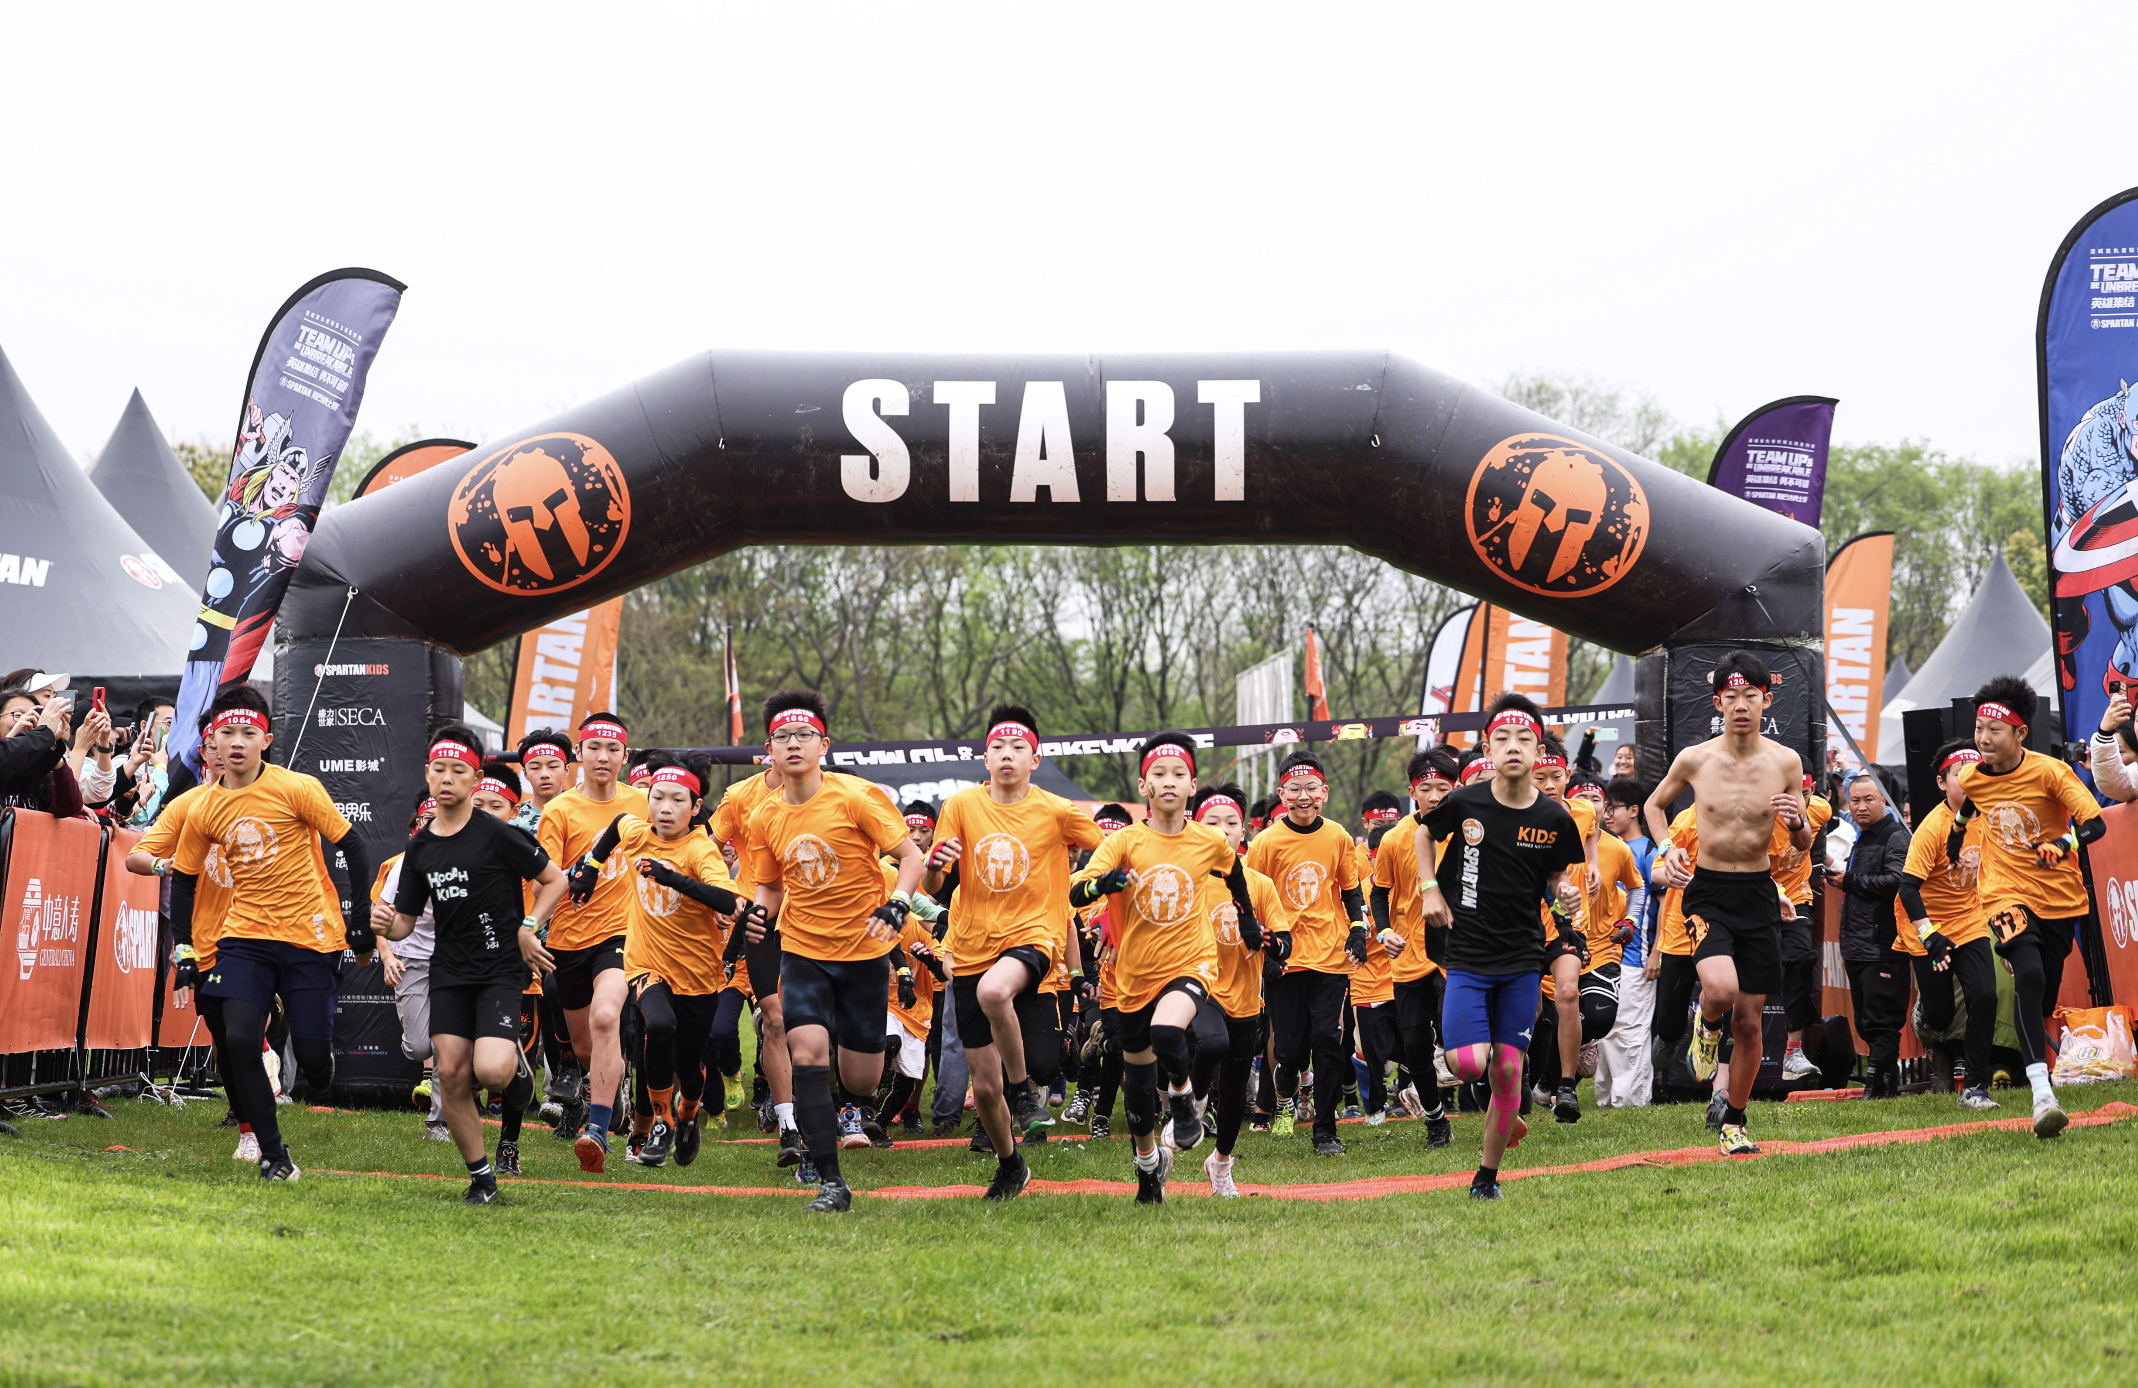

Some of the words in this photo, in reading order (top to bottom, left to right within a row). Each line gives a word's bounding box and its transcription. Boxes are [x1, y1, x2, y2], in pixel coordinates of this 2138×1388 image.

[2101, 319, 2135, 328] SPARTAN
[298, 325, 336, 354] TEAM
[287, 380, 312, 398] SPARTAN
[841, 379, 1260, 503] START
[1747, 449, 1787, 465] TEAM
[1753, 463, 1812, 477] UNBREAKABLE
[1752, 491, 1776, 499] SPARTAN
[225, 709, 258, 719] SPARTAN
[337, 708, 387, 726] SECA
[783, 709, 814, 718] SPARTAN
[1503, 711, 1535, 723] SPARTAN
[1983, 708, 2002, 719] 1385
[227, 716, 251, 724] 1064
[786, 715, 809, 723] 1060
[1505, 718, 1530, 727] 1178
[595, 723, 622, 733] SPARTAN
[1000, 728, 1023, 736] 1190
[597, 730, 617, 738] 1235
[439, 742, 468, 753] SPARTAN
[438, 750, 460, 758] 1195
[656, 767, 685, 777] SPARTAN
[657, 774, 677, 782] 1250
[1518, 826, 1558, 844] KIDS
[1461, 845, 1480, 909] SPARTAN
[42, 894, 80, 943] 中意人寿
